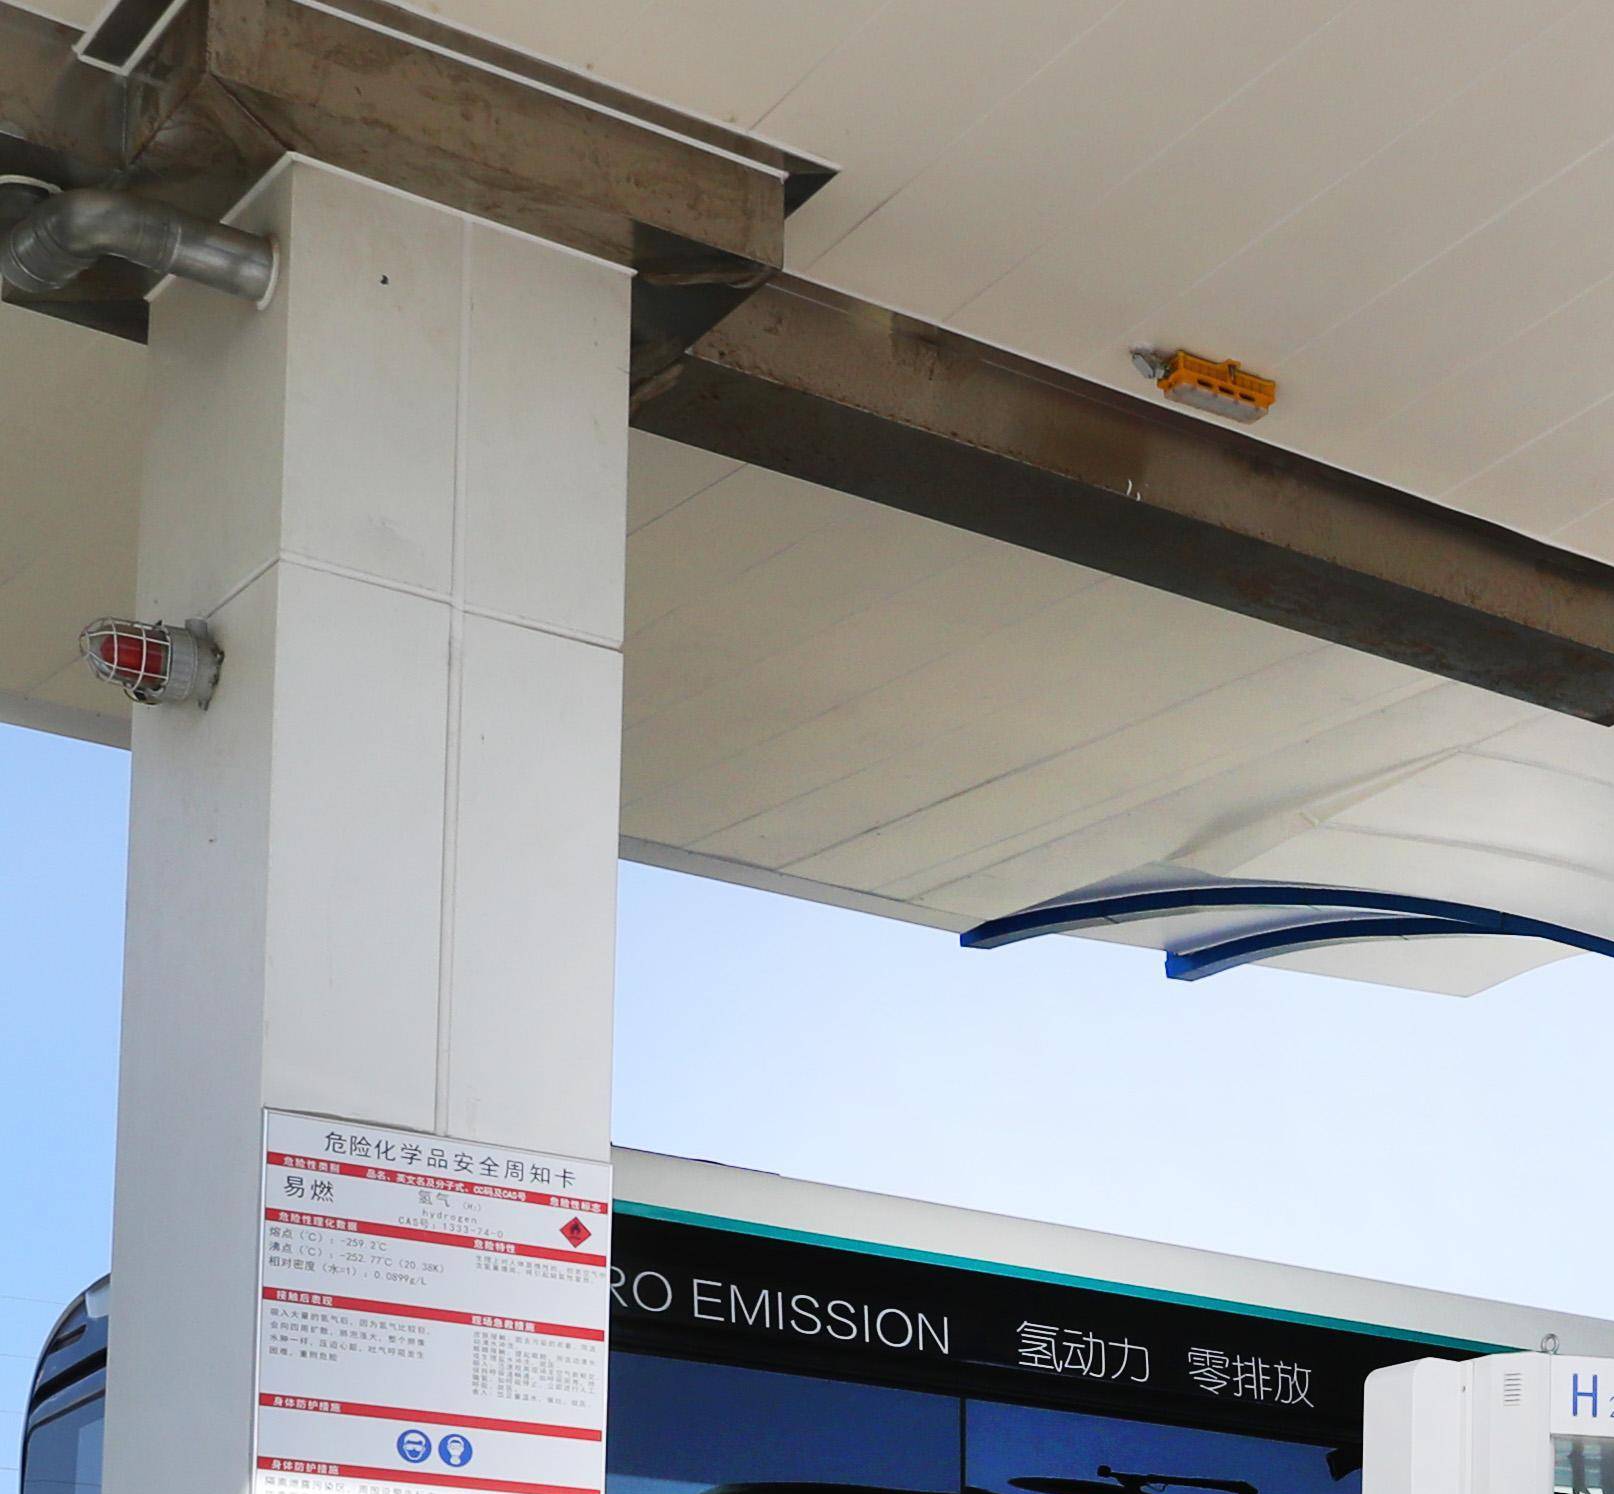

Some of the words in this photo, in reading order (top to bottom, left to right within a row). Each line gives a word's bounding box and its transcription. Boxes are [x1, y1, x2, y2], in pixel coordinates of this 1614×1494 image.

[324, 1131, 576, 1189] 危险化学品安全周知卡
[283, 1175, 334, 1202] 易燃
[278, 1211, 358, 1232] 危险性理化数据
[422, 1209, 477, 1224] hydrogen
[693, 1278, 949, 1355] EMISSION
[1016, 1320, 1150, 1382] 氢动力
[1187, 1347, 1314, 1408] 零排放
